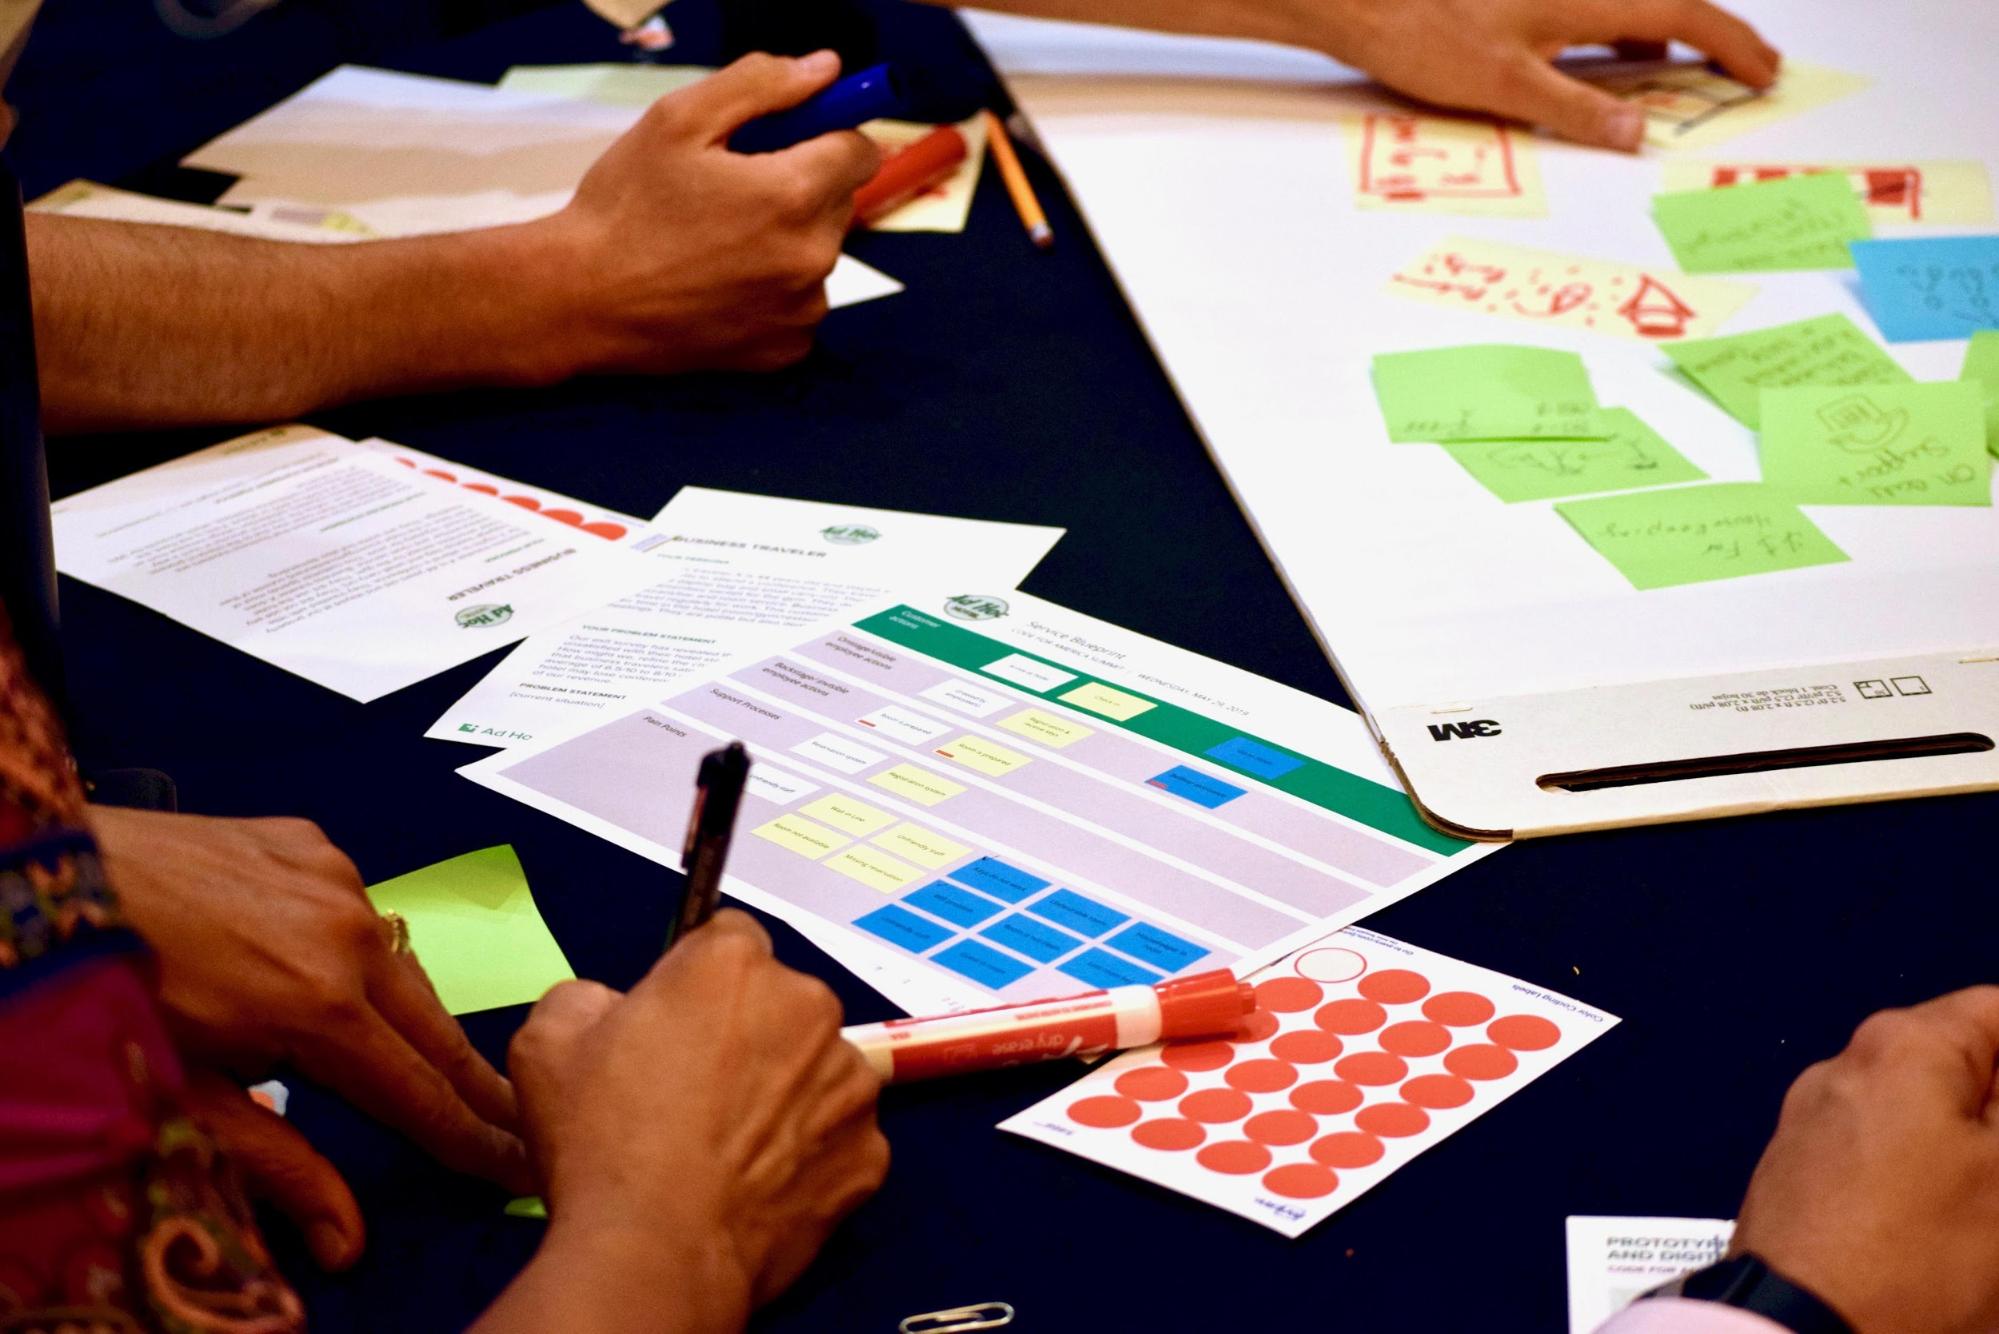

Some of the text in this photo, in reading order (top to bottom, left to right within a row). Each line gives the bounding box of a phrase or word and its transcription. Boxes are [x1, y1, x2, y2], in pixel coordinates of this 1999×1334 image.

[752, 542, 828, 559] TRAVELER
[492, 603, 515, 619] Ad
[901, 610, 942, 628] Customer
[457, 613, 494, 629] Hoc
[889, 616, 920, 630] actions
[582, 624, 717, 644] YOUR PROBLEM STATEMENT
[1028, 620, 1127, 660] Service Blueprint
[825, 641, 892, 671] employee actions
[1055, 642, 1090, 659] AMERICA
[762, 666, 830, 697] employee actions
[519, 683, 627, 700] PROBLEM STATEMENT
[709, 688, 784, 722] Support Processes
[481, 728, 532, 741] Ad Ho
[643, 715, 688, 738] Pain Points
[1427, 718, 1503, 742] 3M
[1511, 983, 1605, 1023] Color Coding Labels
[991, 1037, 1035, 1056] erase
[1038, 1031, 1065, 1048] dry
[1606, 1236, 1726, 1248] PROTOTYP
[1607, 1249, 1719, 1261] AND DIGIT
